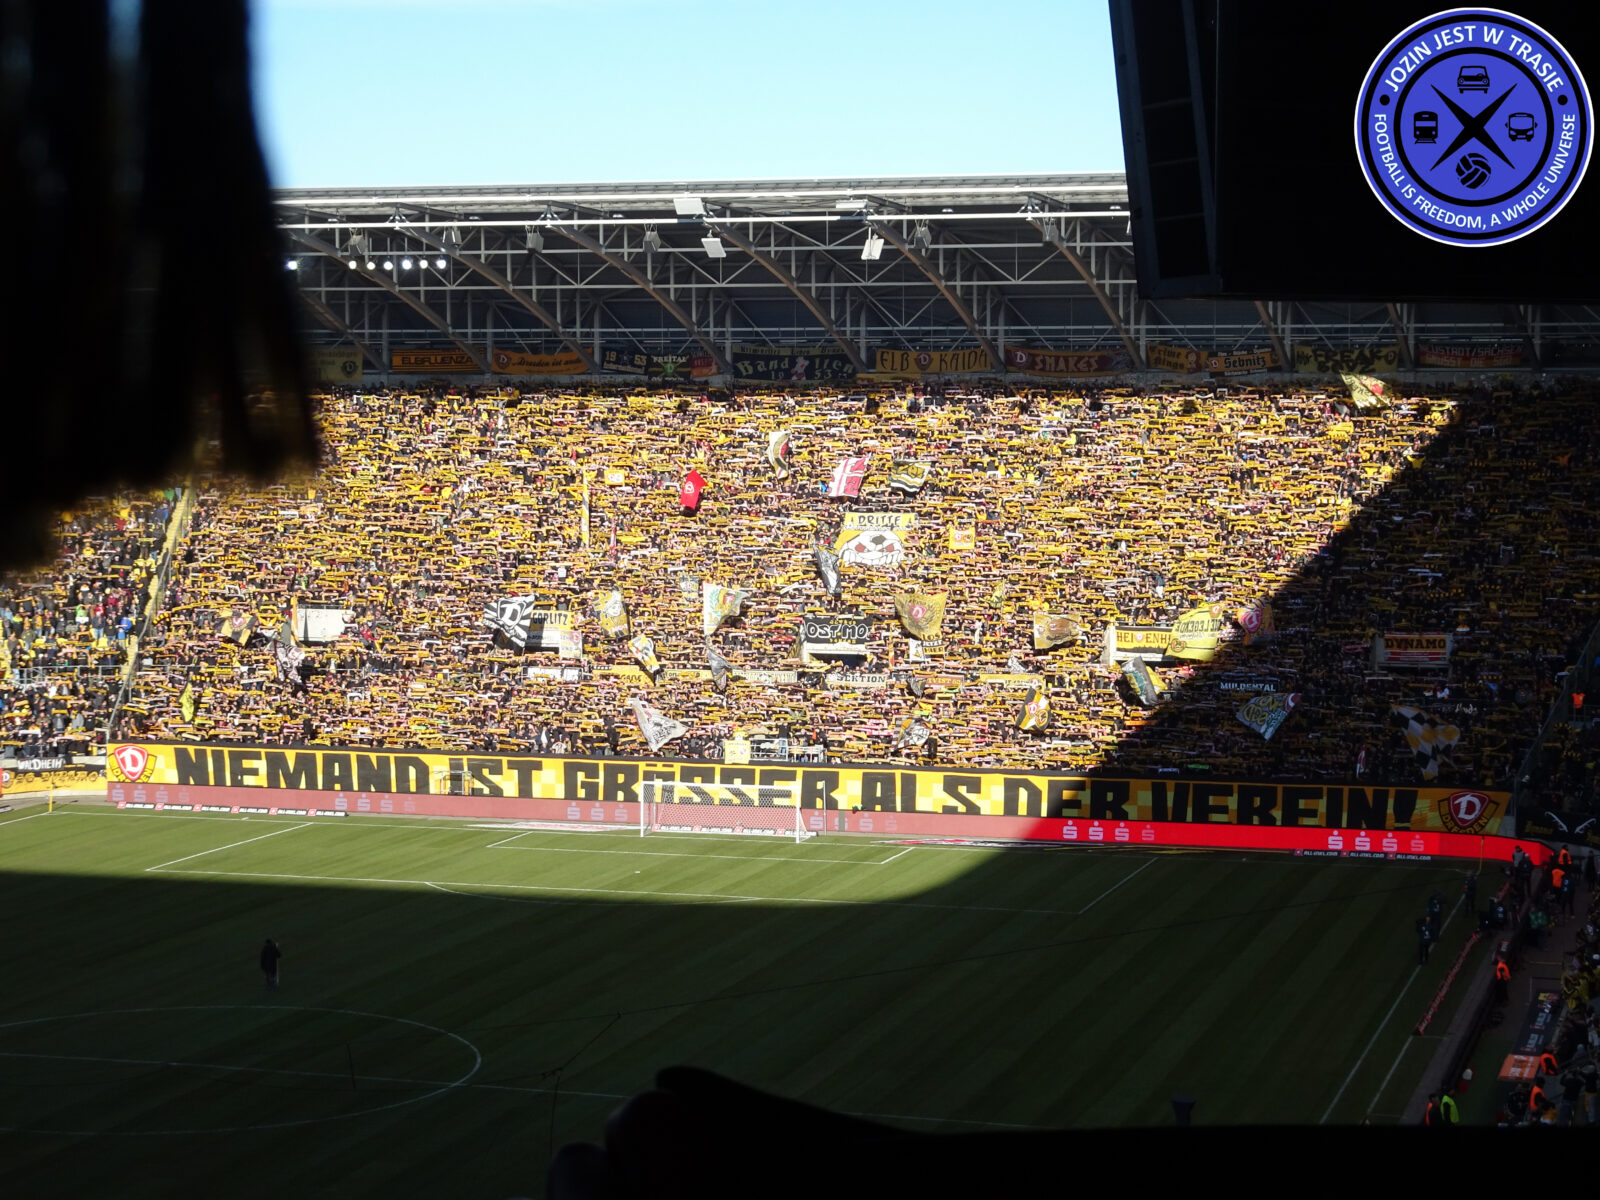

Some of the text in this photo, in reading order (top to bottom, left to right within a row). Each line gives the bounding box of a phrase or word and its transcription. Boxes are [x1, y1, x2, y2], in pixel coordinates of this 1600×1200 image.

[605, 351, 647, 366] 19 53
[880, 349, 988, 371] ELB KAIDA
[1034, 355, 1099, 373] SNAKES
[1224, 356, 1266, 369] Sebnitz
[857, 514, 902, 525] DRITTE
[1384, 638, 1447, 649] DYNAMO
[1219, 681, 1277, 692] MULDENTAL
[174, 748, 1419, 831] NIEMAND IST GRÖSSER ALS DER VEREIN!
